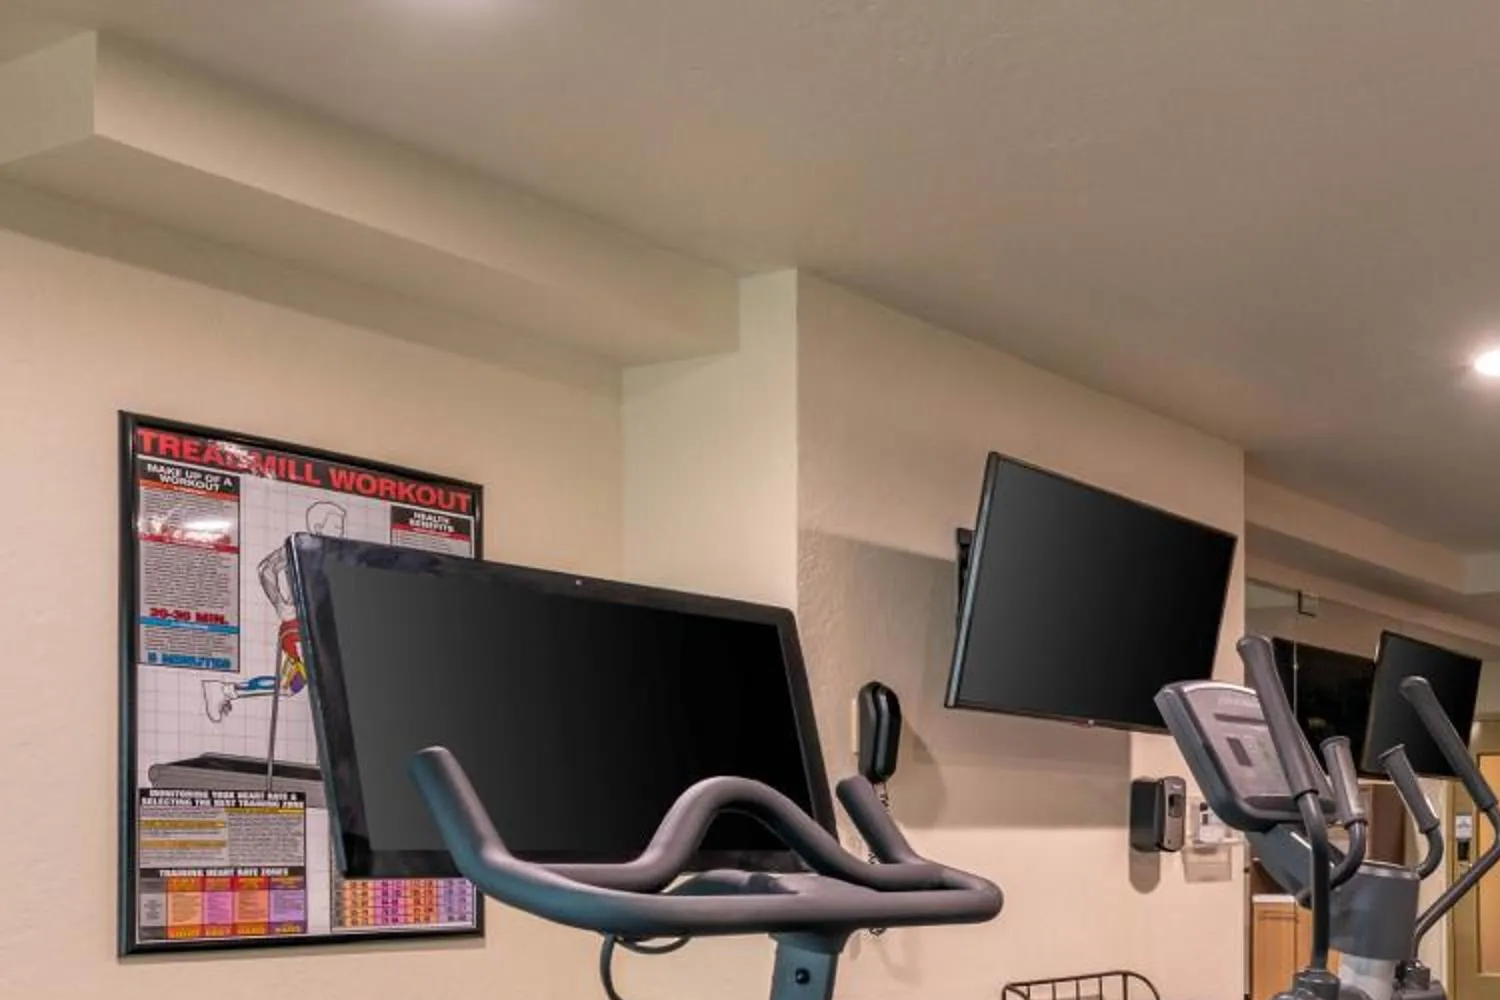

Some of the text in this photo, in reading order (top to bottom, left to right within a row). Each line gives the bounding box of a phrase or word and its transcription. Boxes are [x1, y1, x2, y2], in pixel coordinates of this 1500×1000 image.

[137, 428, 472, 513] TREADMILL WORKOUT
[147, 463, 233, 487] MAKE UP OF A
[160, 474, 220, 491] WORKOUT
